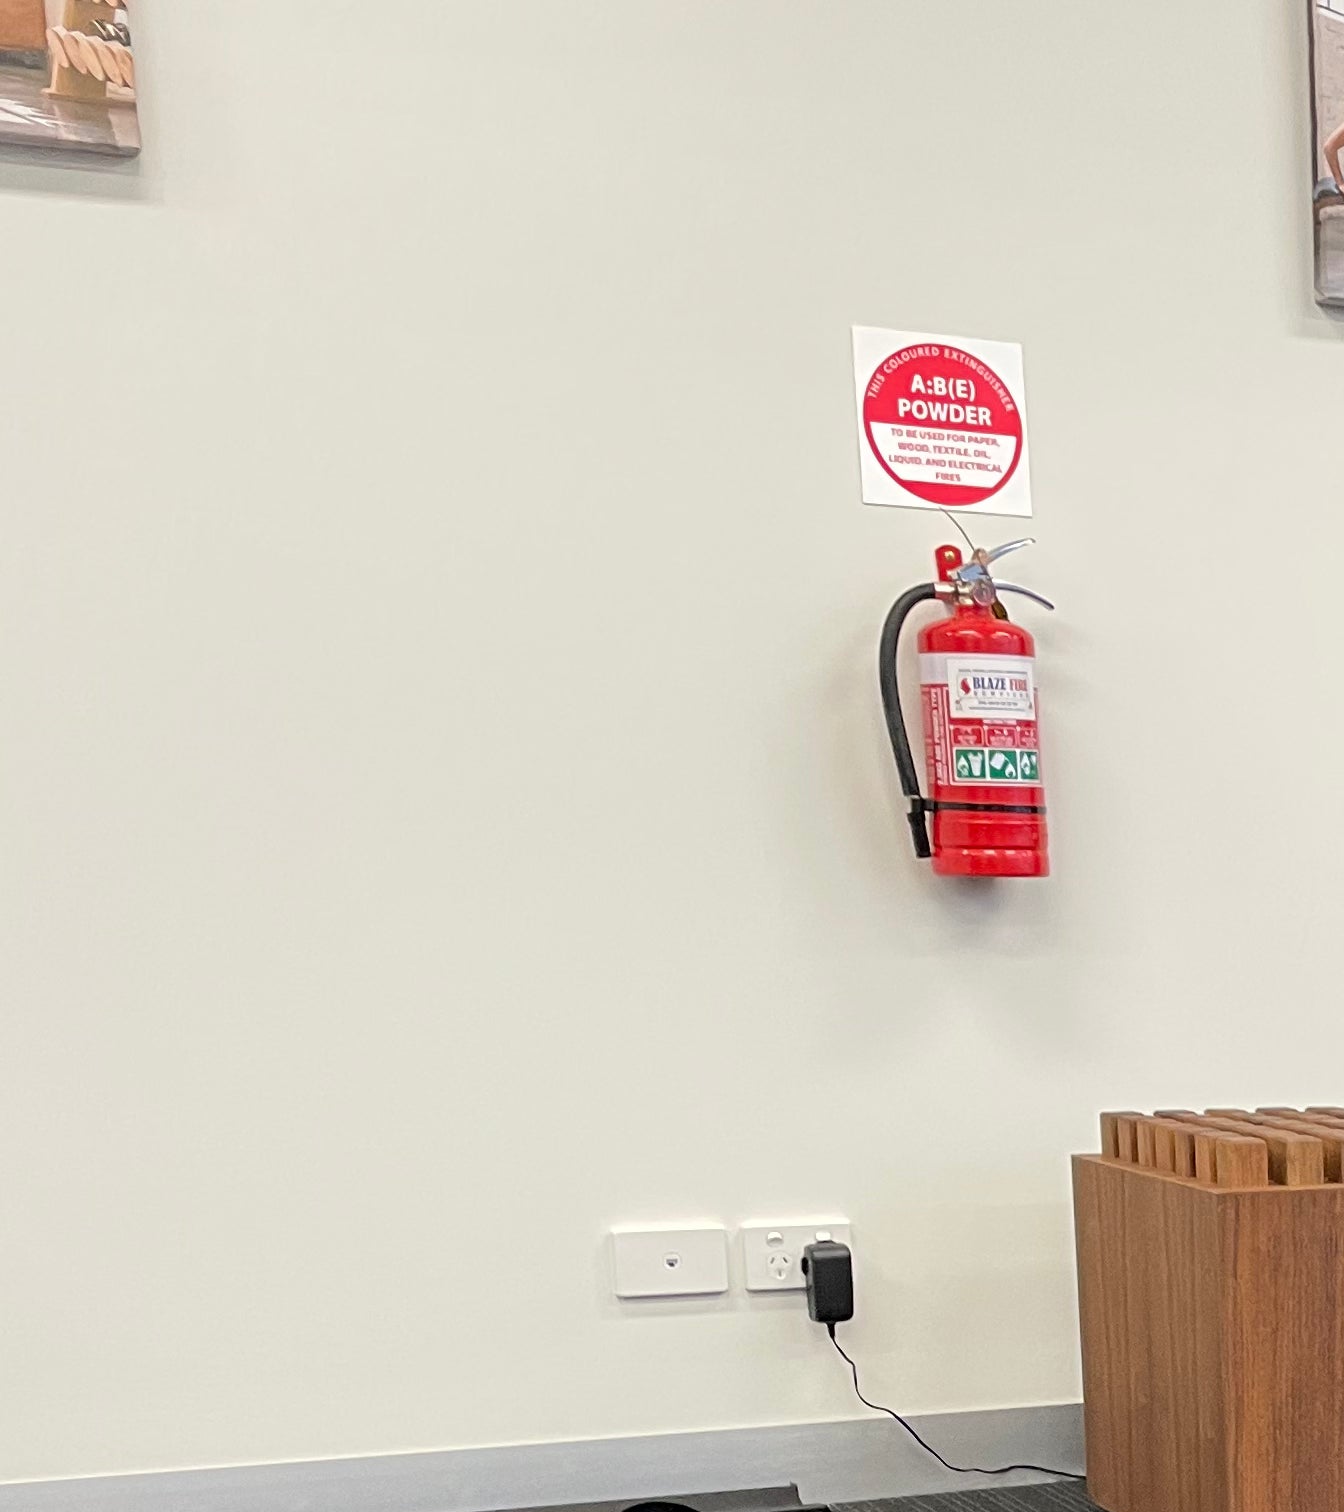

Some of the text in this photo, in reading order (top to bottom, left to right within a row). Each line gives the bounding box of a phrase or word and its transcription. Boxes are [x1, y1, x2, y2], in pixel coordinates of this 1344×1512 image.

[867, 346, 1015, 412] THIS COLOURED EXTINGUISHER
[911, 373, 976, 402] A:B(E)
[897, 398, 993, 426] POWDER
[891, 428, 903, 437] TO
[906, 430, 917, 439] BE
[919, 431, 945, 440] USED
[947, 434, 966, 443] FOR
[926, 459, 946, 468] AND
[972, 677, 1006, 691] BLAZE
